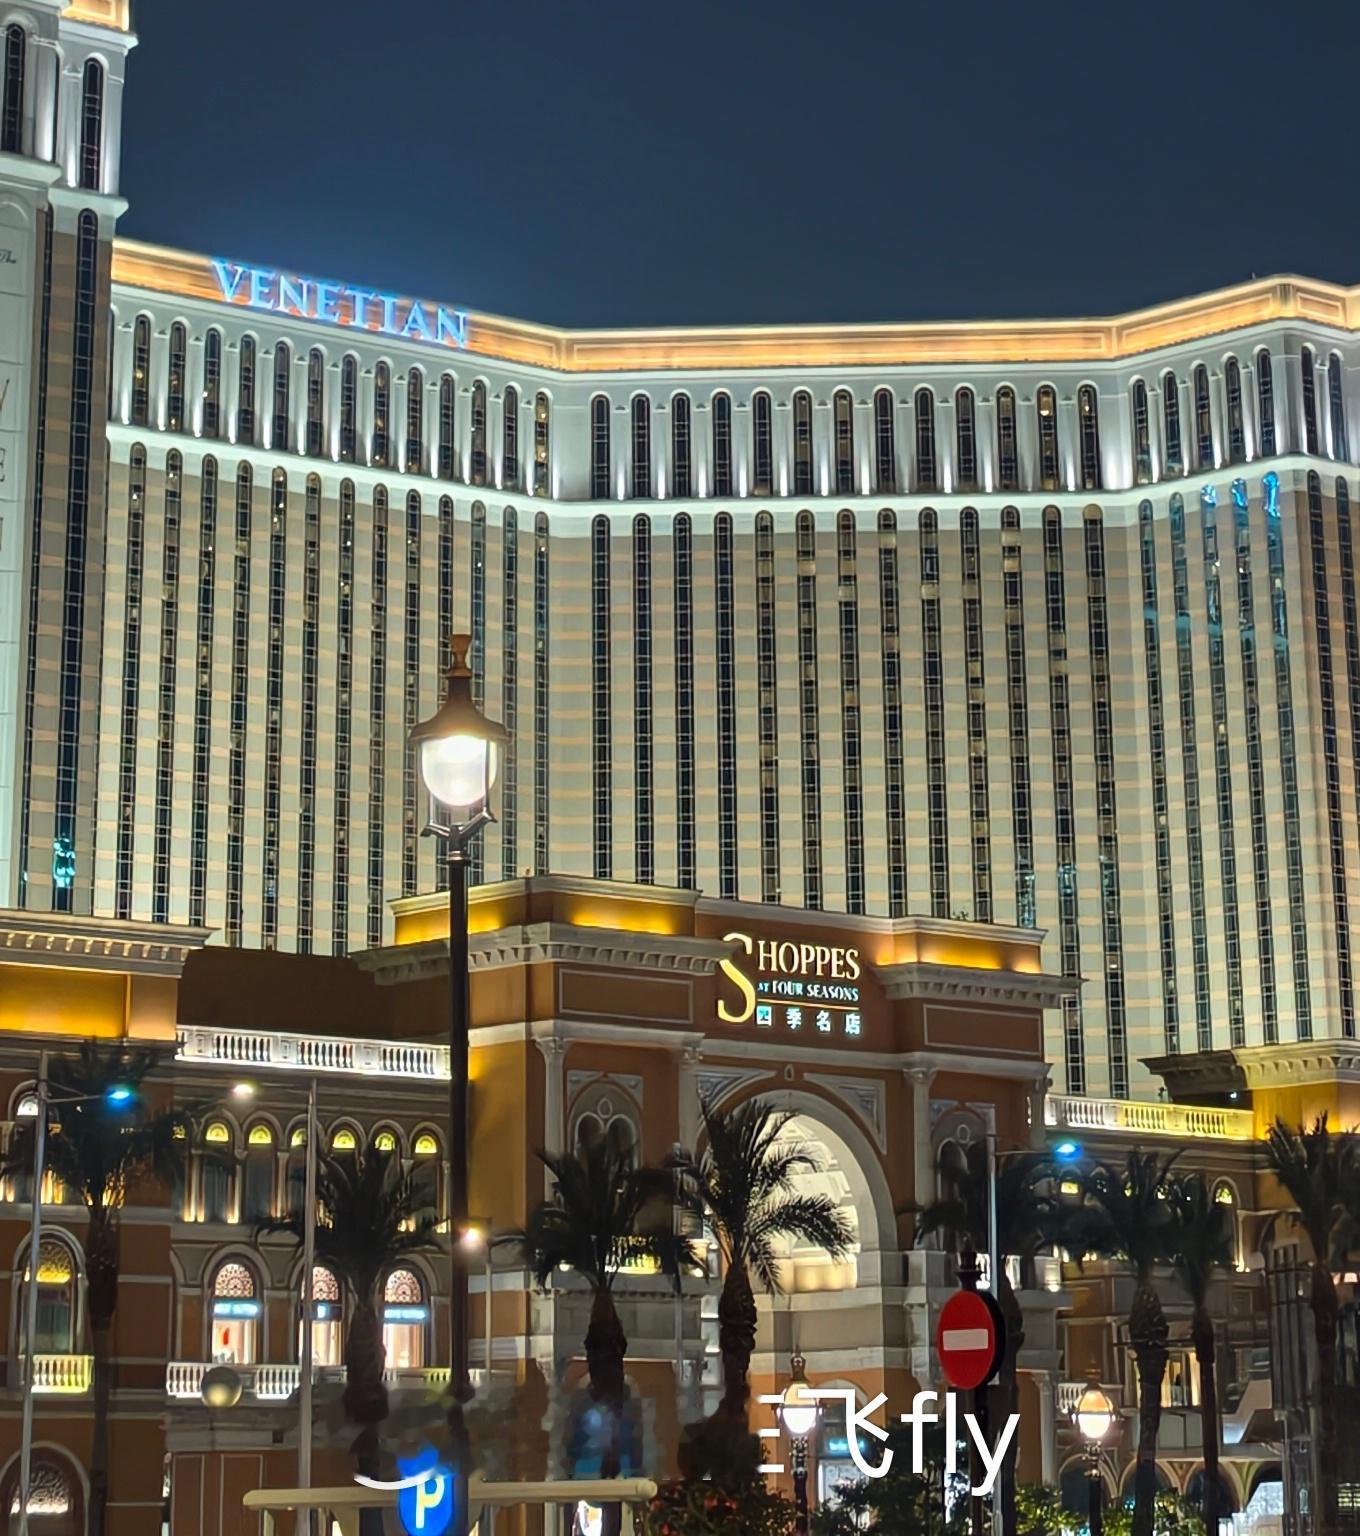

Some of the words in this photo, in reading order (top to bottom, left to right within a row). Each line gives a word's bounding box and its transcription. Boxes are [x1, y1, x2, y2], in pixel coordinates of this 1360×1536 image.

[211, 258, 470, 349] VENETIAN
[717, 931, 862, 1024] SHOPPES
[757, 981, 769, 994] AT
[772, 980, 804, 996] FOUR
[806, 983, 860, 1003] SEASONS
[756, 1005, 862, 1036] 四季名店
[415, 1472, 446, 1529] P
